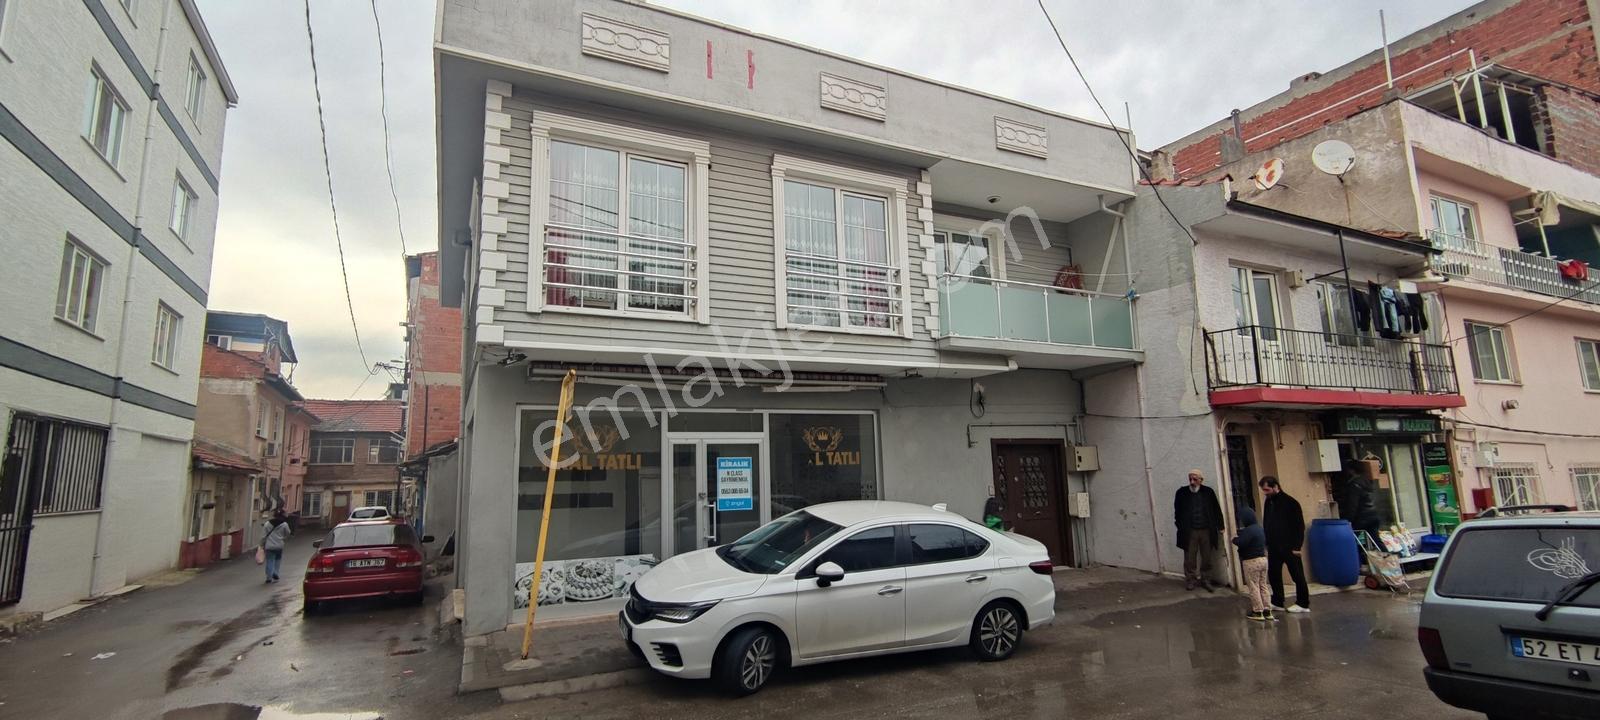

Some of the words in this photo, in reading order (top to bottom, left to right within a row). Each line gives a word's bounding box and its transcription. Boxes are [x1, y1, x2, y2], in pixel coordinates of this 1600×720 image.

[826, 451, 860, 465] TATLI
[1523, 640, 1549, 657] 52
[1558, 643, 1582, 661] ET
